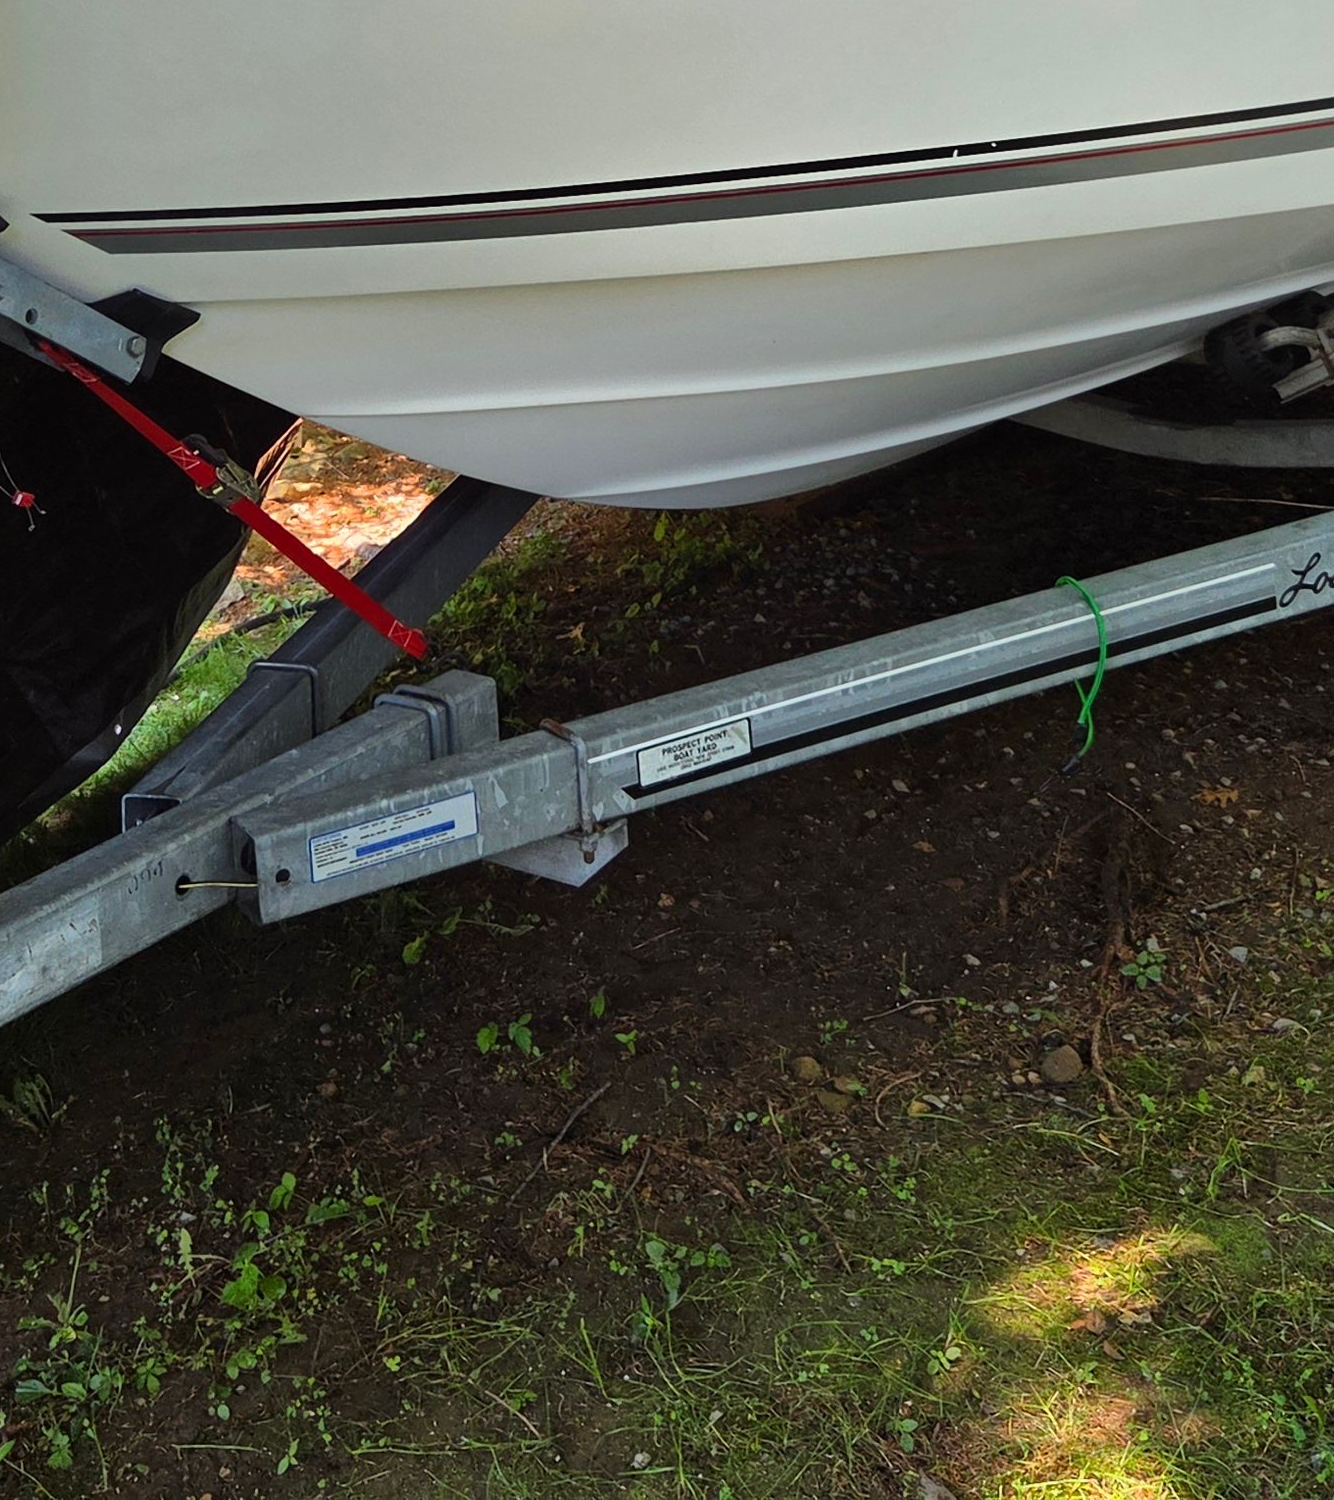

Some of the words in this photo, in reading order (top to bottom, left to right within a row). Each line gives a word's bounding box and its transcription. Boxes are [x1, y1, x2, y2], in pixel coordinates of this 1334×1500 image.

[662, 738, 700, 756] PROSPECT
[705, 729, 727, 743] POINT
[674, 749, 694, 762] BOAT
[698, 742, 717, 755] YARD
